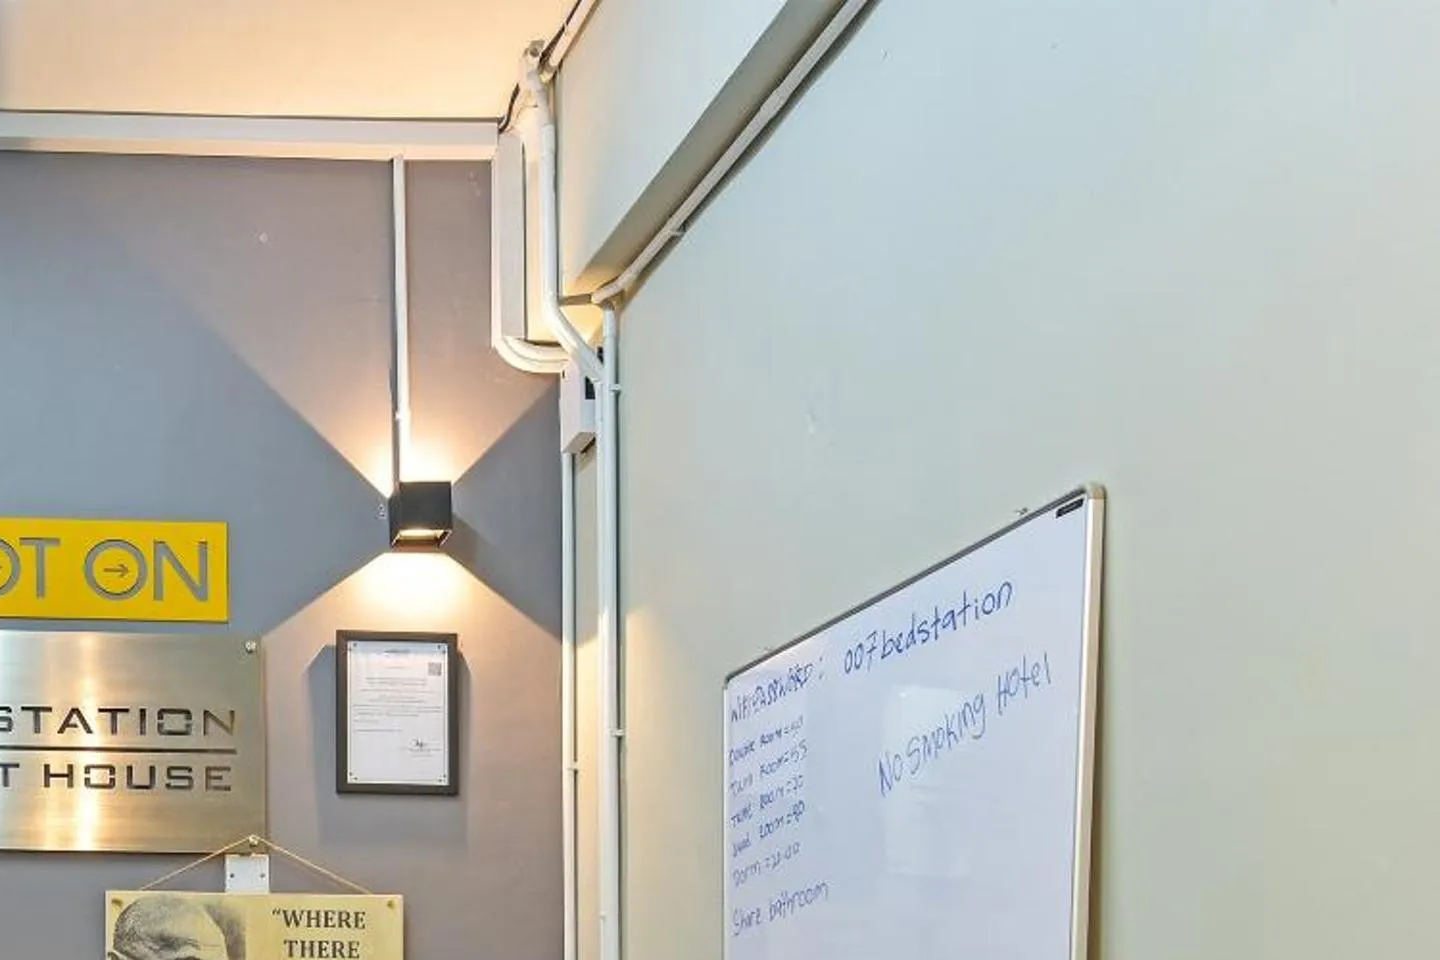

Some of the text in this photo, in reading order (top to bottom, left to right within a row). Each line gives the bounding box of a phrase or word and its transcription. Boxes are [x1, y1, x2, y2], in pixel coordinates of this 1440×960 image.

[83, 538, 210, 602] ON
[43, 763, 232, 792] HOUSE
[283, 939, 361, 959] THERE
